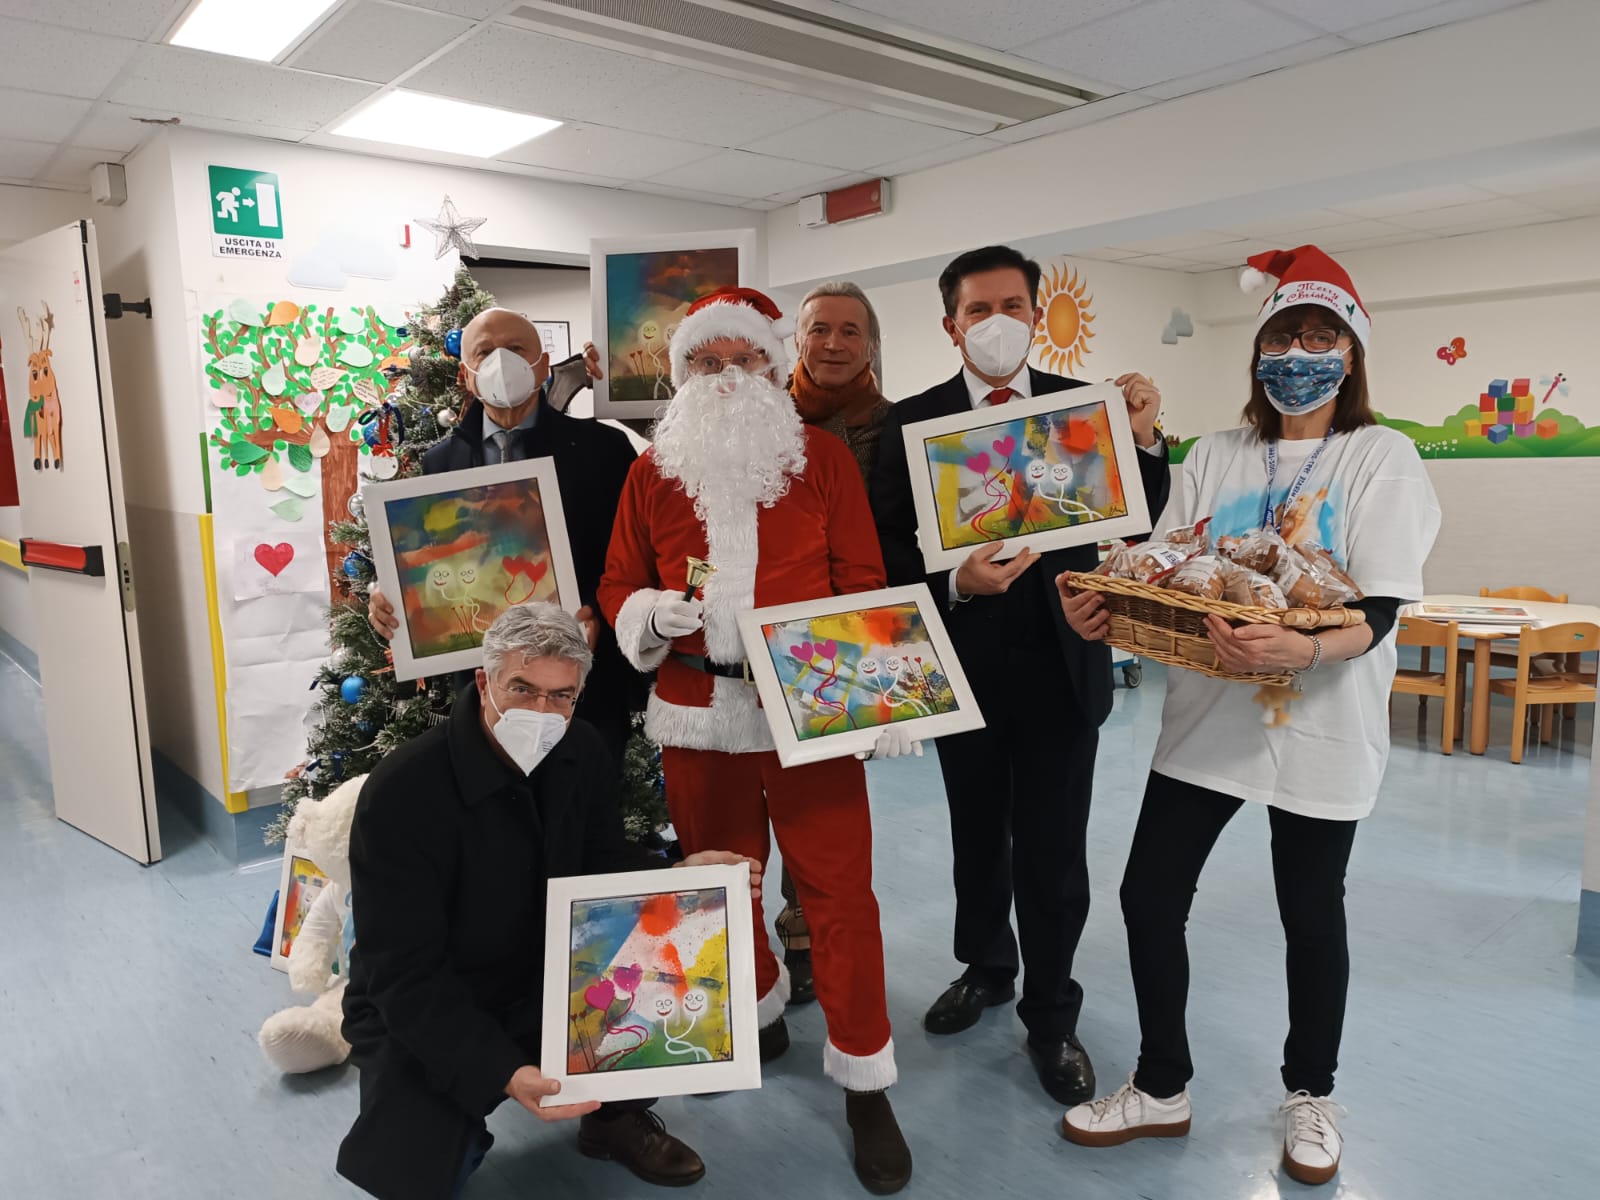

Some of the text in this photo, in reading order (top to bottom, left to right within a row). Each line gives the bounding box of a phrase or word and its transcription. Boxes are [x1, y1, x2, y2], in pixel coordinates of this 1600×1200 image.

[225, 237, 275, 249] USCITA DI
[219, 246, 282, 258] EMERGENZA
[1296, 282, 1339, 300] Merry
